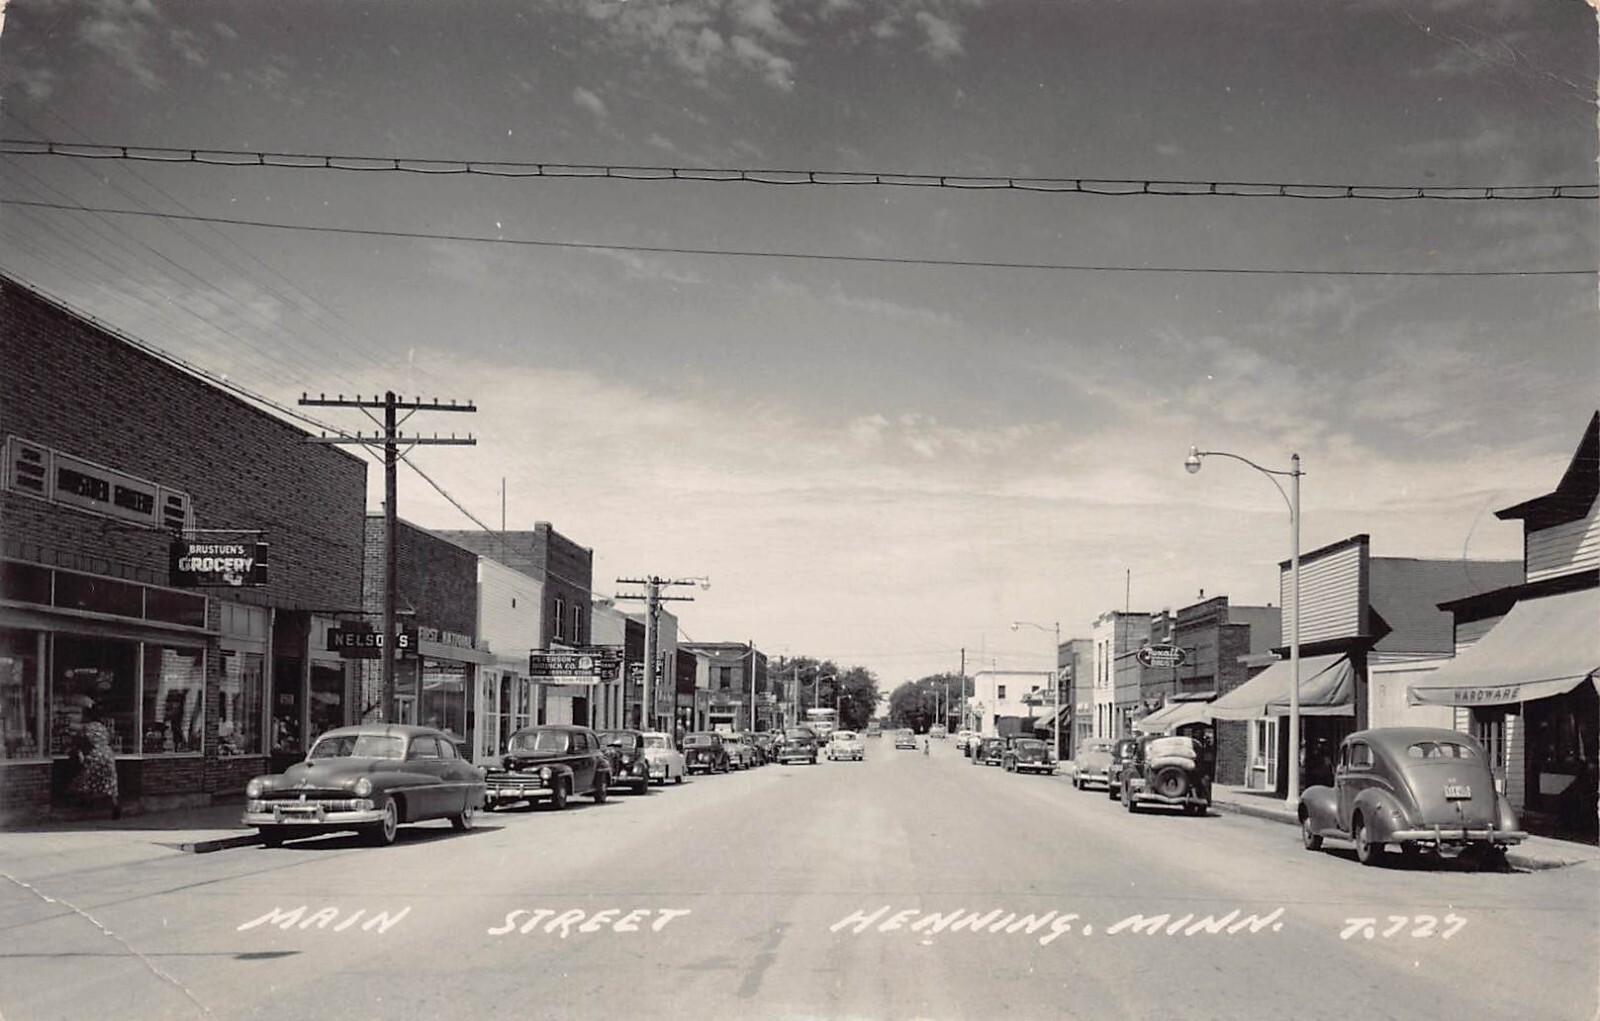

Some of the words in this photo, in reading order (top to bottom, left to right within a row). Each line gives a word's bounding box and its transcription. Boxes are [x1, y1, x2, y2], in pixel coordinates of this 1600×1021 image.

[178, 557, 254, 572] GROCERY
[334, 632, 408, 648] NELSO'S
[1454, 687, 1521, 704] HARDWARE
